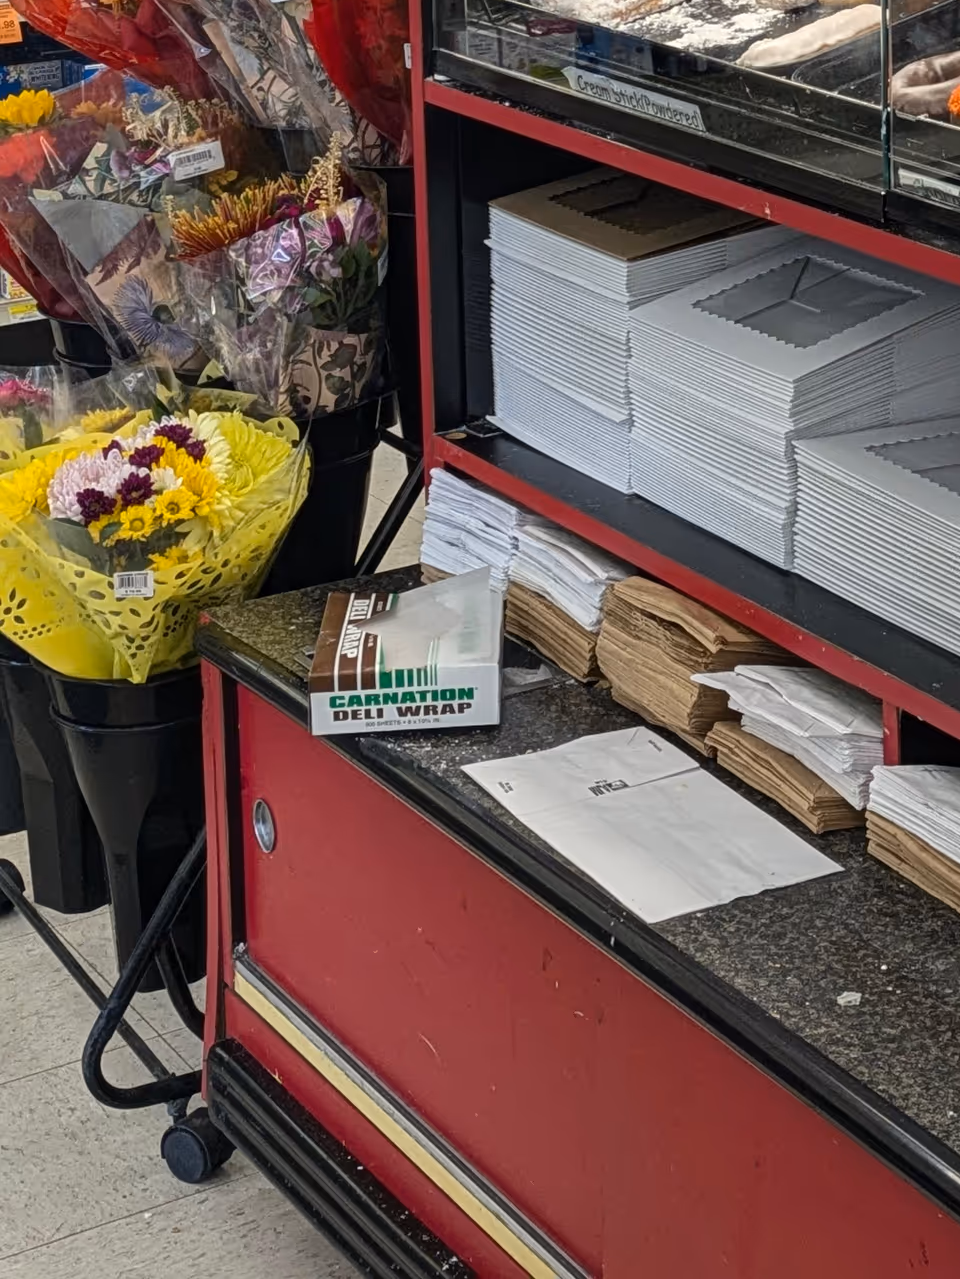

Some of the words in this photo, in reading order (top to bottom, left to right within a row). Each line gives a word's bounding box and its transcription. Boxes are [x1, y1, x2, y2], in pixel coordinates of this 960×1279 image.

[577, 75, 611, 101] Cream
[350, 599, 370, 620] DELI
[329, 687, 475, 709] CARNATION
[333, 708, 384, 722] DELI
[396, 702, 472, 717] WRAP
